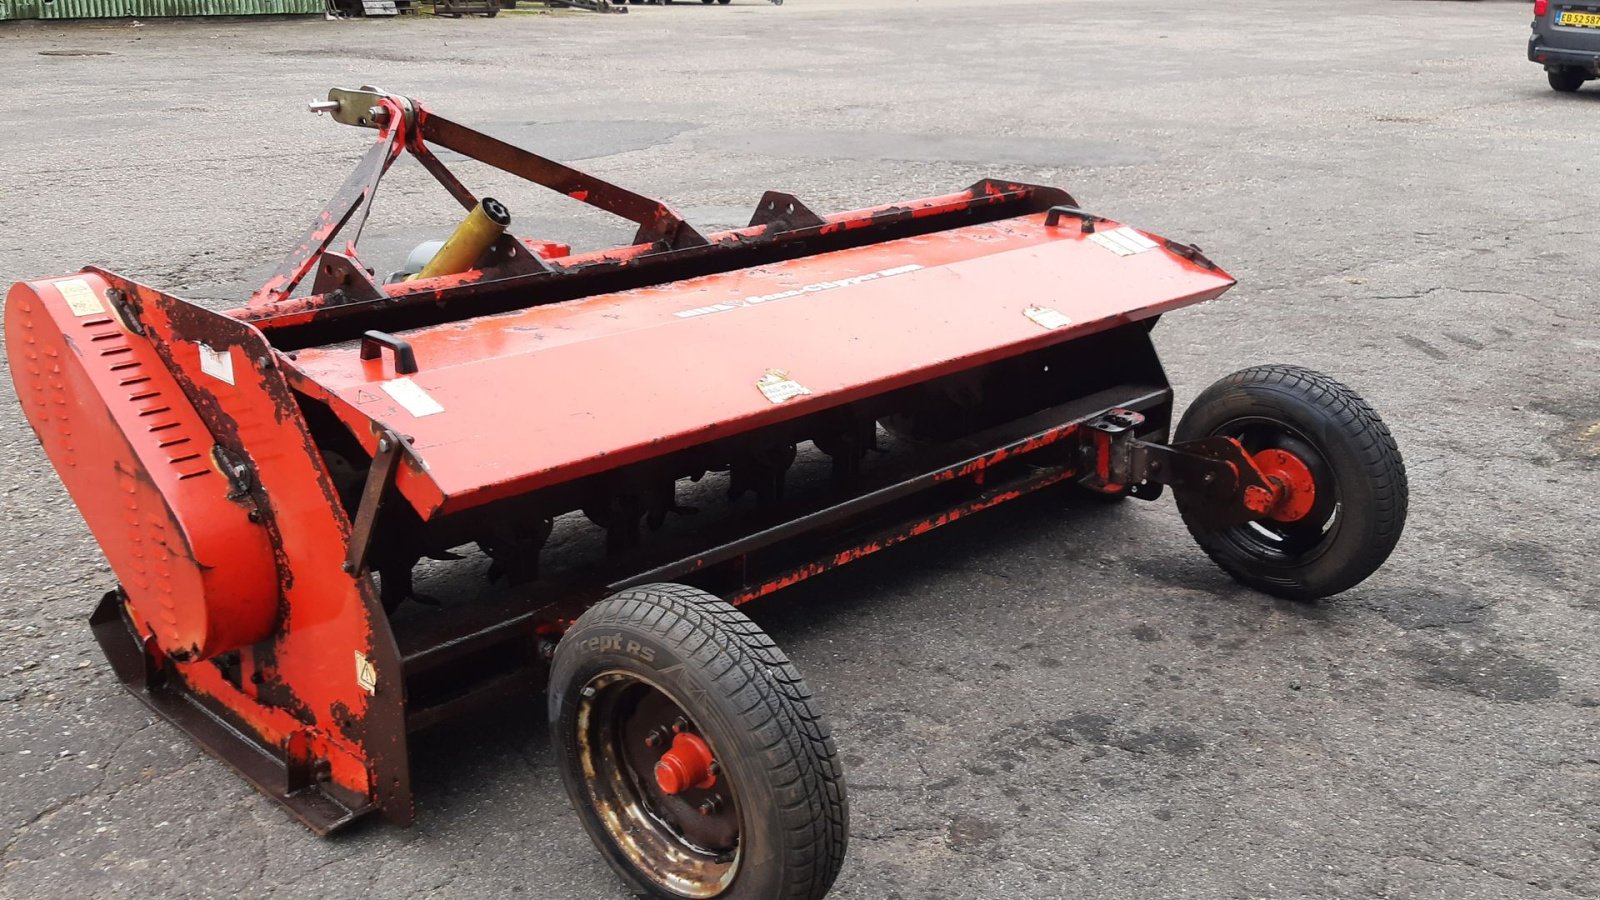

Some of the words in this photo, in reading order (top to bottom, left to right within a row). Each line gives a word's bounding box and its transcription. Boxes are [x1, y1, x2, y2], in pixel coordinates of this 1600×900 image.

[1573, 14, 1584, 23] 52
[1585, 15, 1600, 25] 587
[626, 640, 656, 662] RS
